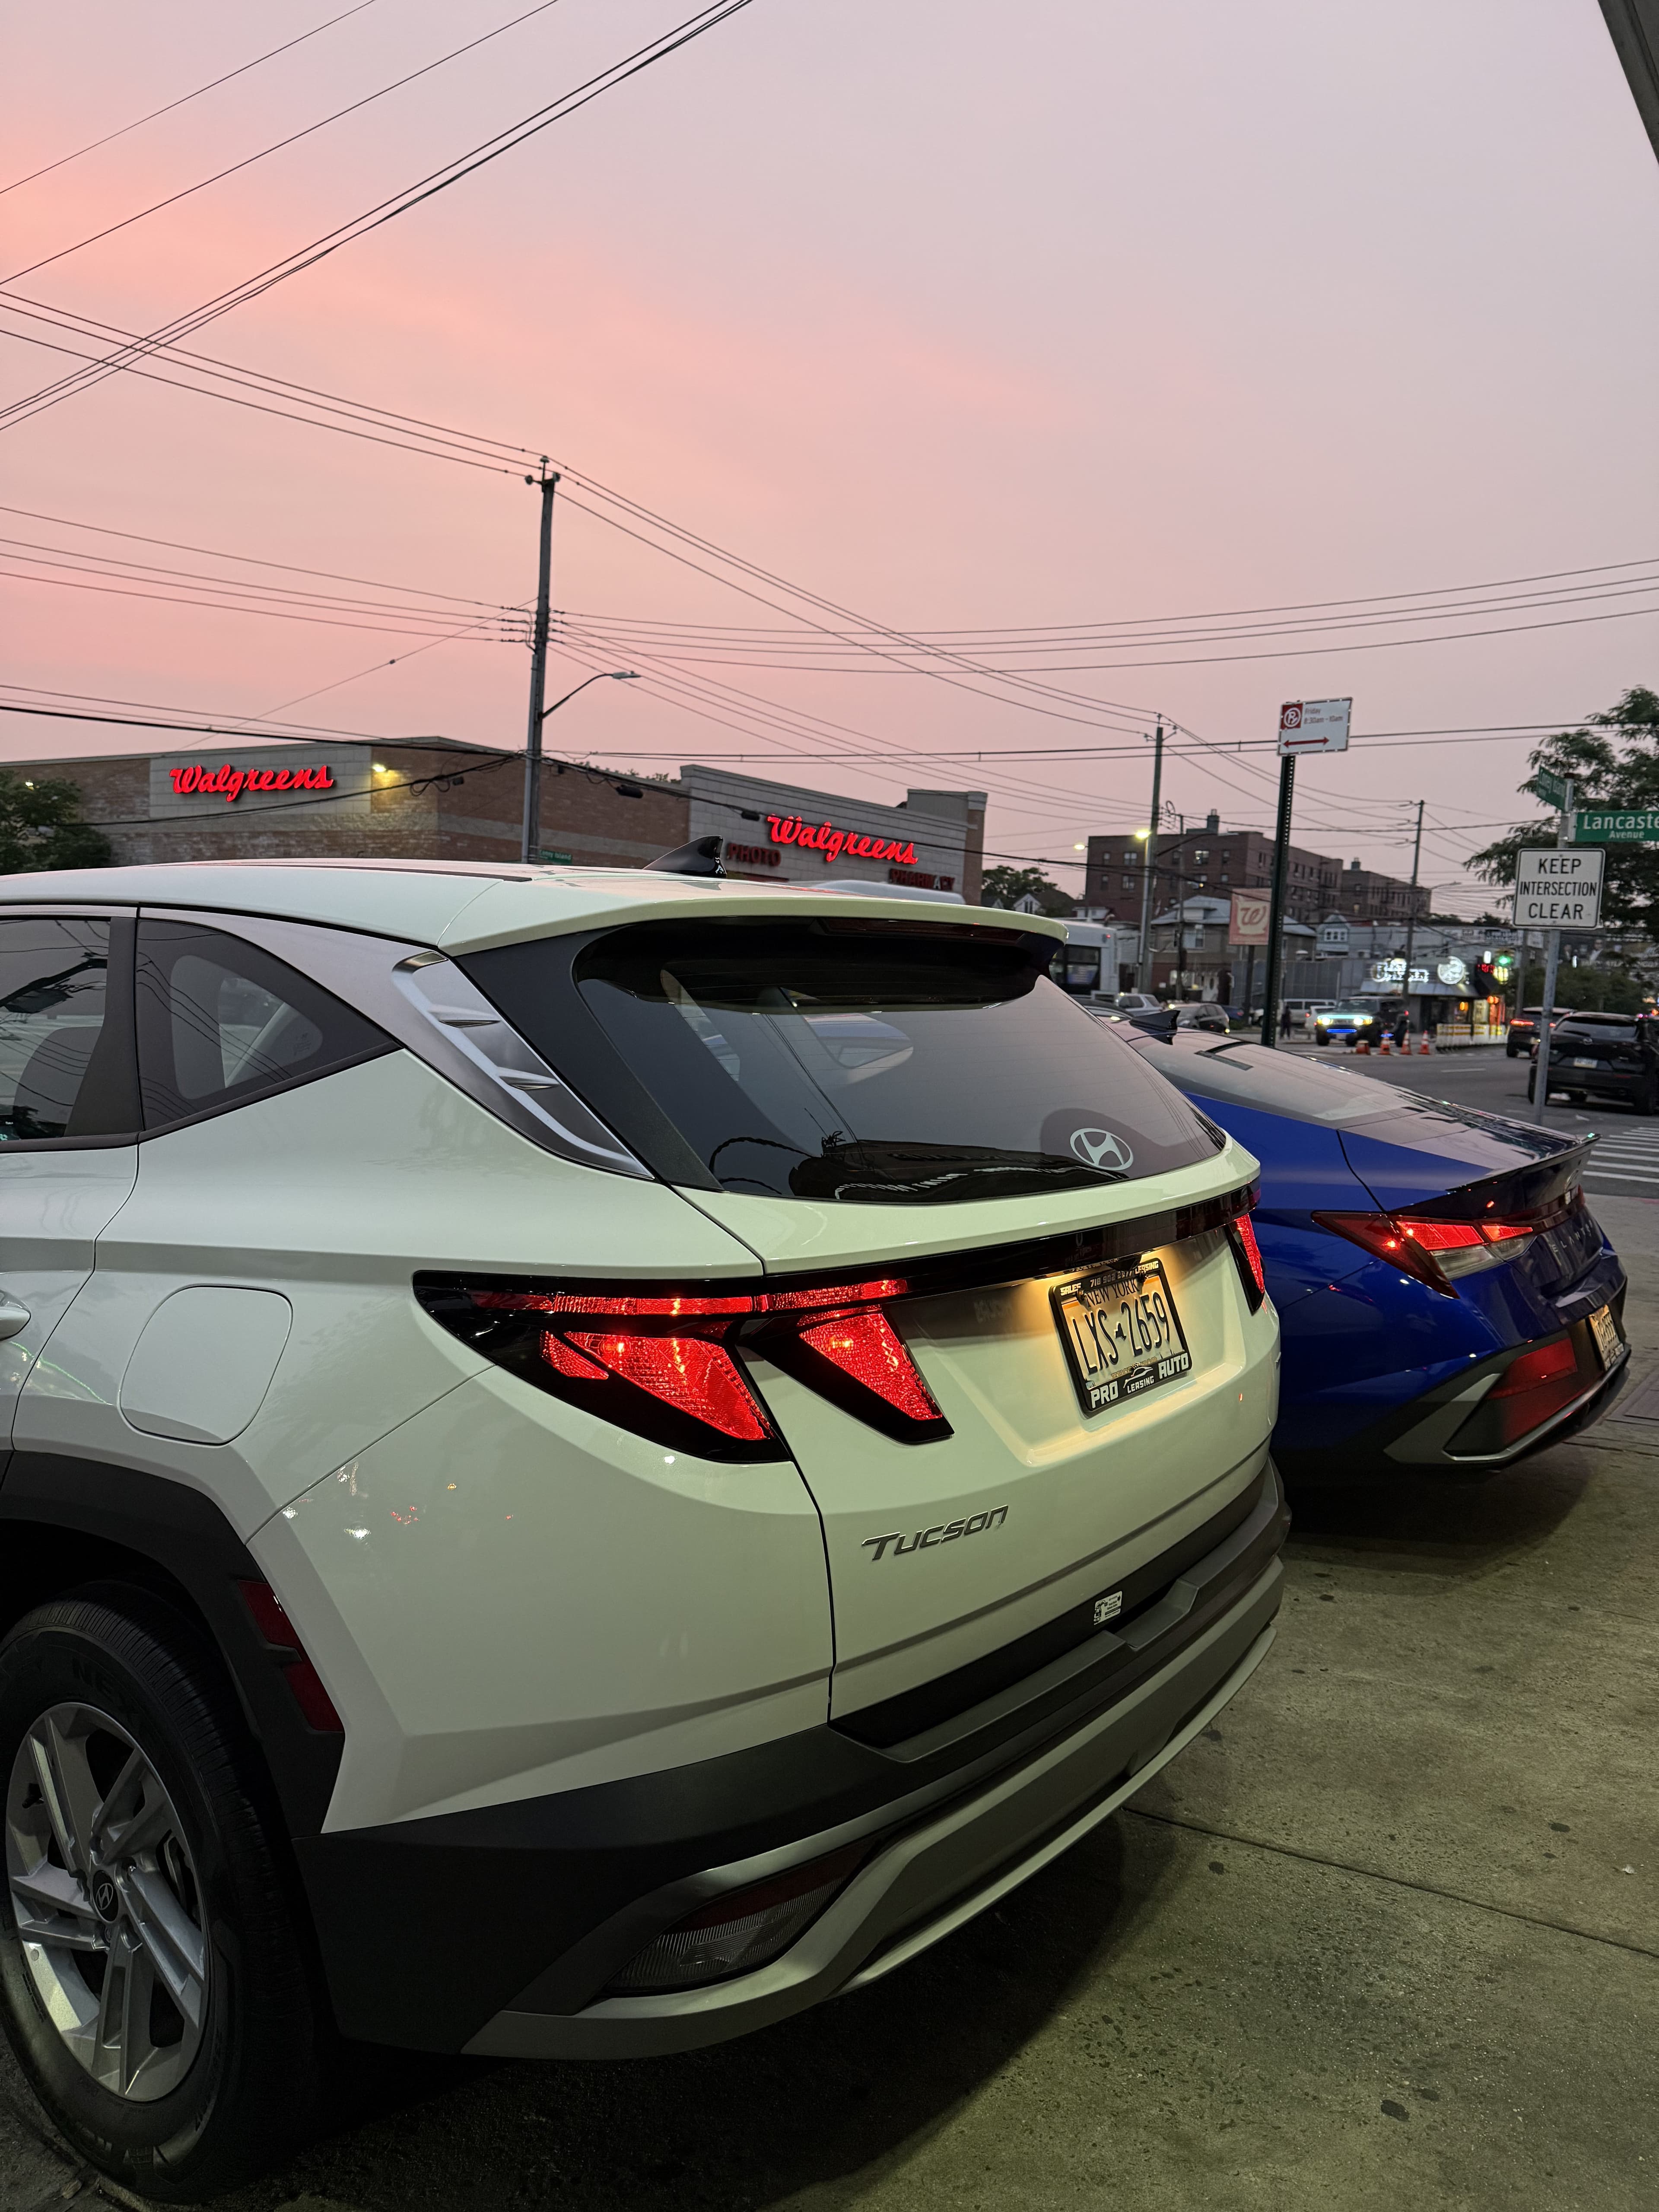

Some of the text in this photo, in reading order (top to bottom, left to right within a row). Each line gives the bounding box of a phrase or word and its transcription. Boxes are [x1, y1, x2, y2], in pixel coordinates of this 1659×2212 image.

[169, 764, 334, 802] Walgreens
[767, 814, 918, 864] Walgreens
[1608, 830, 1645, 839] Avenue
[727, 842, 782, 867] PHOTO
[1538, 858, 1582, 874] KEEP
[889, 868, 956, 891] PHARMACY
[1519, 881, 1597, 896] INTERSECTION
[1528, 903, 1584, 920] CLEAR
[1060, 1282, 1081, 1296] SALES
[1090, 1279, 1101, 1287] 718
[1103, 1274, 1116, 1284] 902
[1086, 1278, 1141, 1307] NEW YORK
[1090, 1353, 1189, 1408] PRO LEASING AUTO
